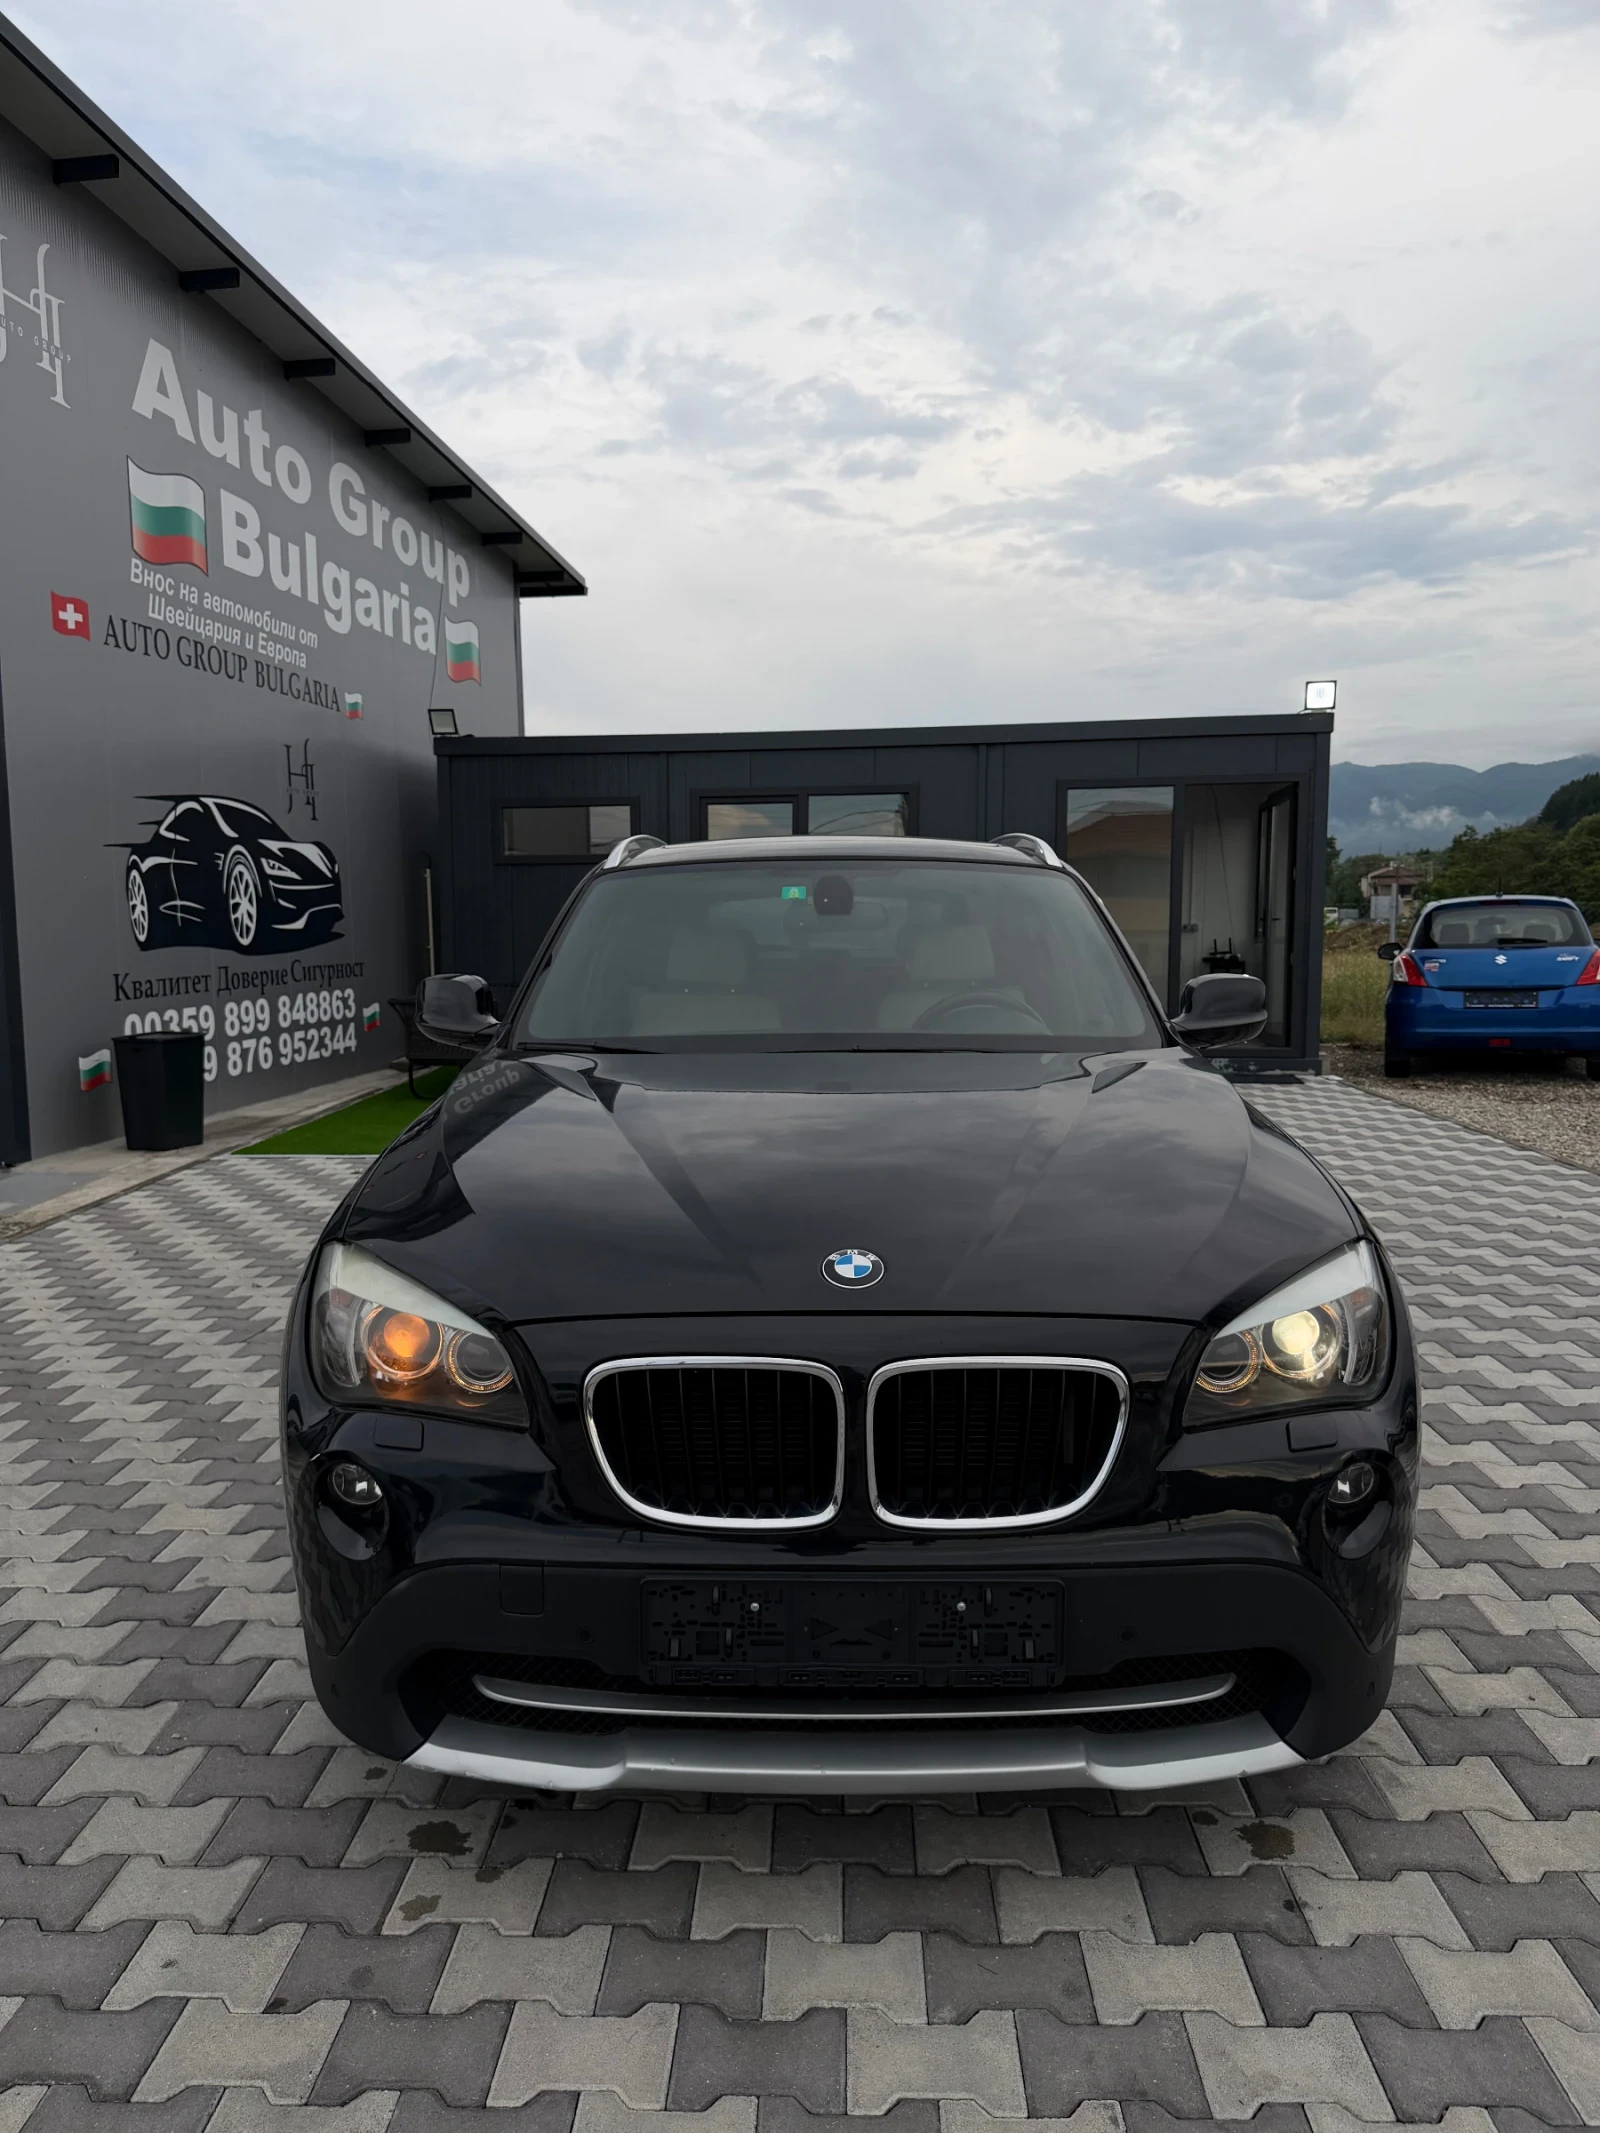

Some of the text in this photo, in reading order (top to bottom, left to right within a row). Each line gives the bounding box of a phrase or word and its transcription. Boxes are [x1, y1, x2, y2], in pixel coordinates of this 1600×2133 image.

[0, 315, 72, 364] UTO GROUP
[132, 338, 470, 608] Auto Group
[130, 557, 319, 650] Внос на автомобили от
[220, 488, 437, 656] Bulgaria
[103, 613, 342, 713] AUTO GROUP BULGARIA
[148, 592, 307, 669] Швейцария и Европа
[112, 958, 365, 1002] Квалитет Доверие Сигурност
[224, 998, 271, 1037] 899
[278, 988, 357, 1029] 848863
[227, 1034, 274, 1077] 876
[278, 1022, 358, 1066] 952344
